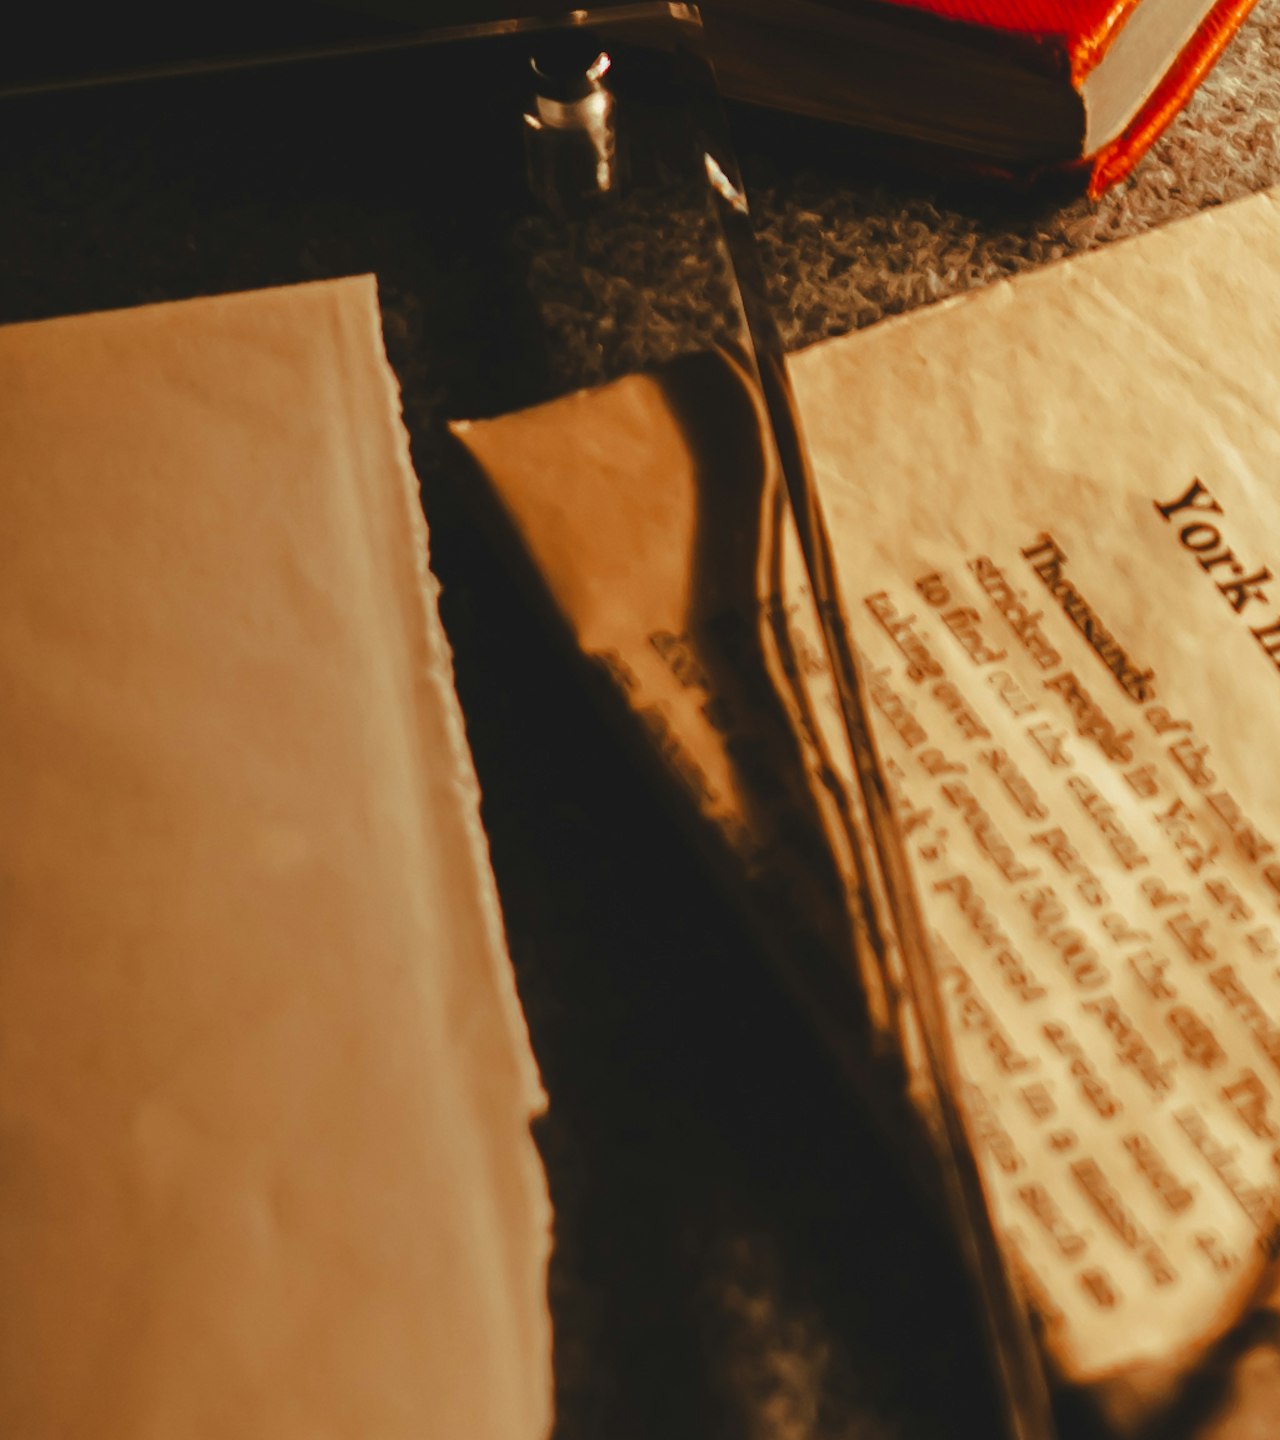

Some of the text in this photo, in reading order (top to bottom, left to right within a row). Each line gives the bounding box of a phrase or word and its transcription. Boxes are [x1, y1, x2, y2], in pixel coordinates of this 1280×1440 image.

[1153, 476, 1273, 615] York
[938, 604, 1011, 669] find
[1019, 529, 1158, 706] Thousands
[1042, 669, 1135, 766] people
